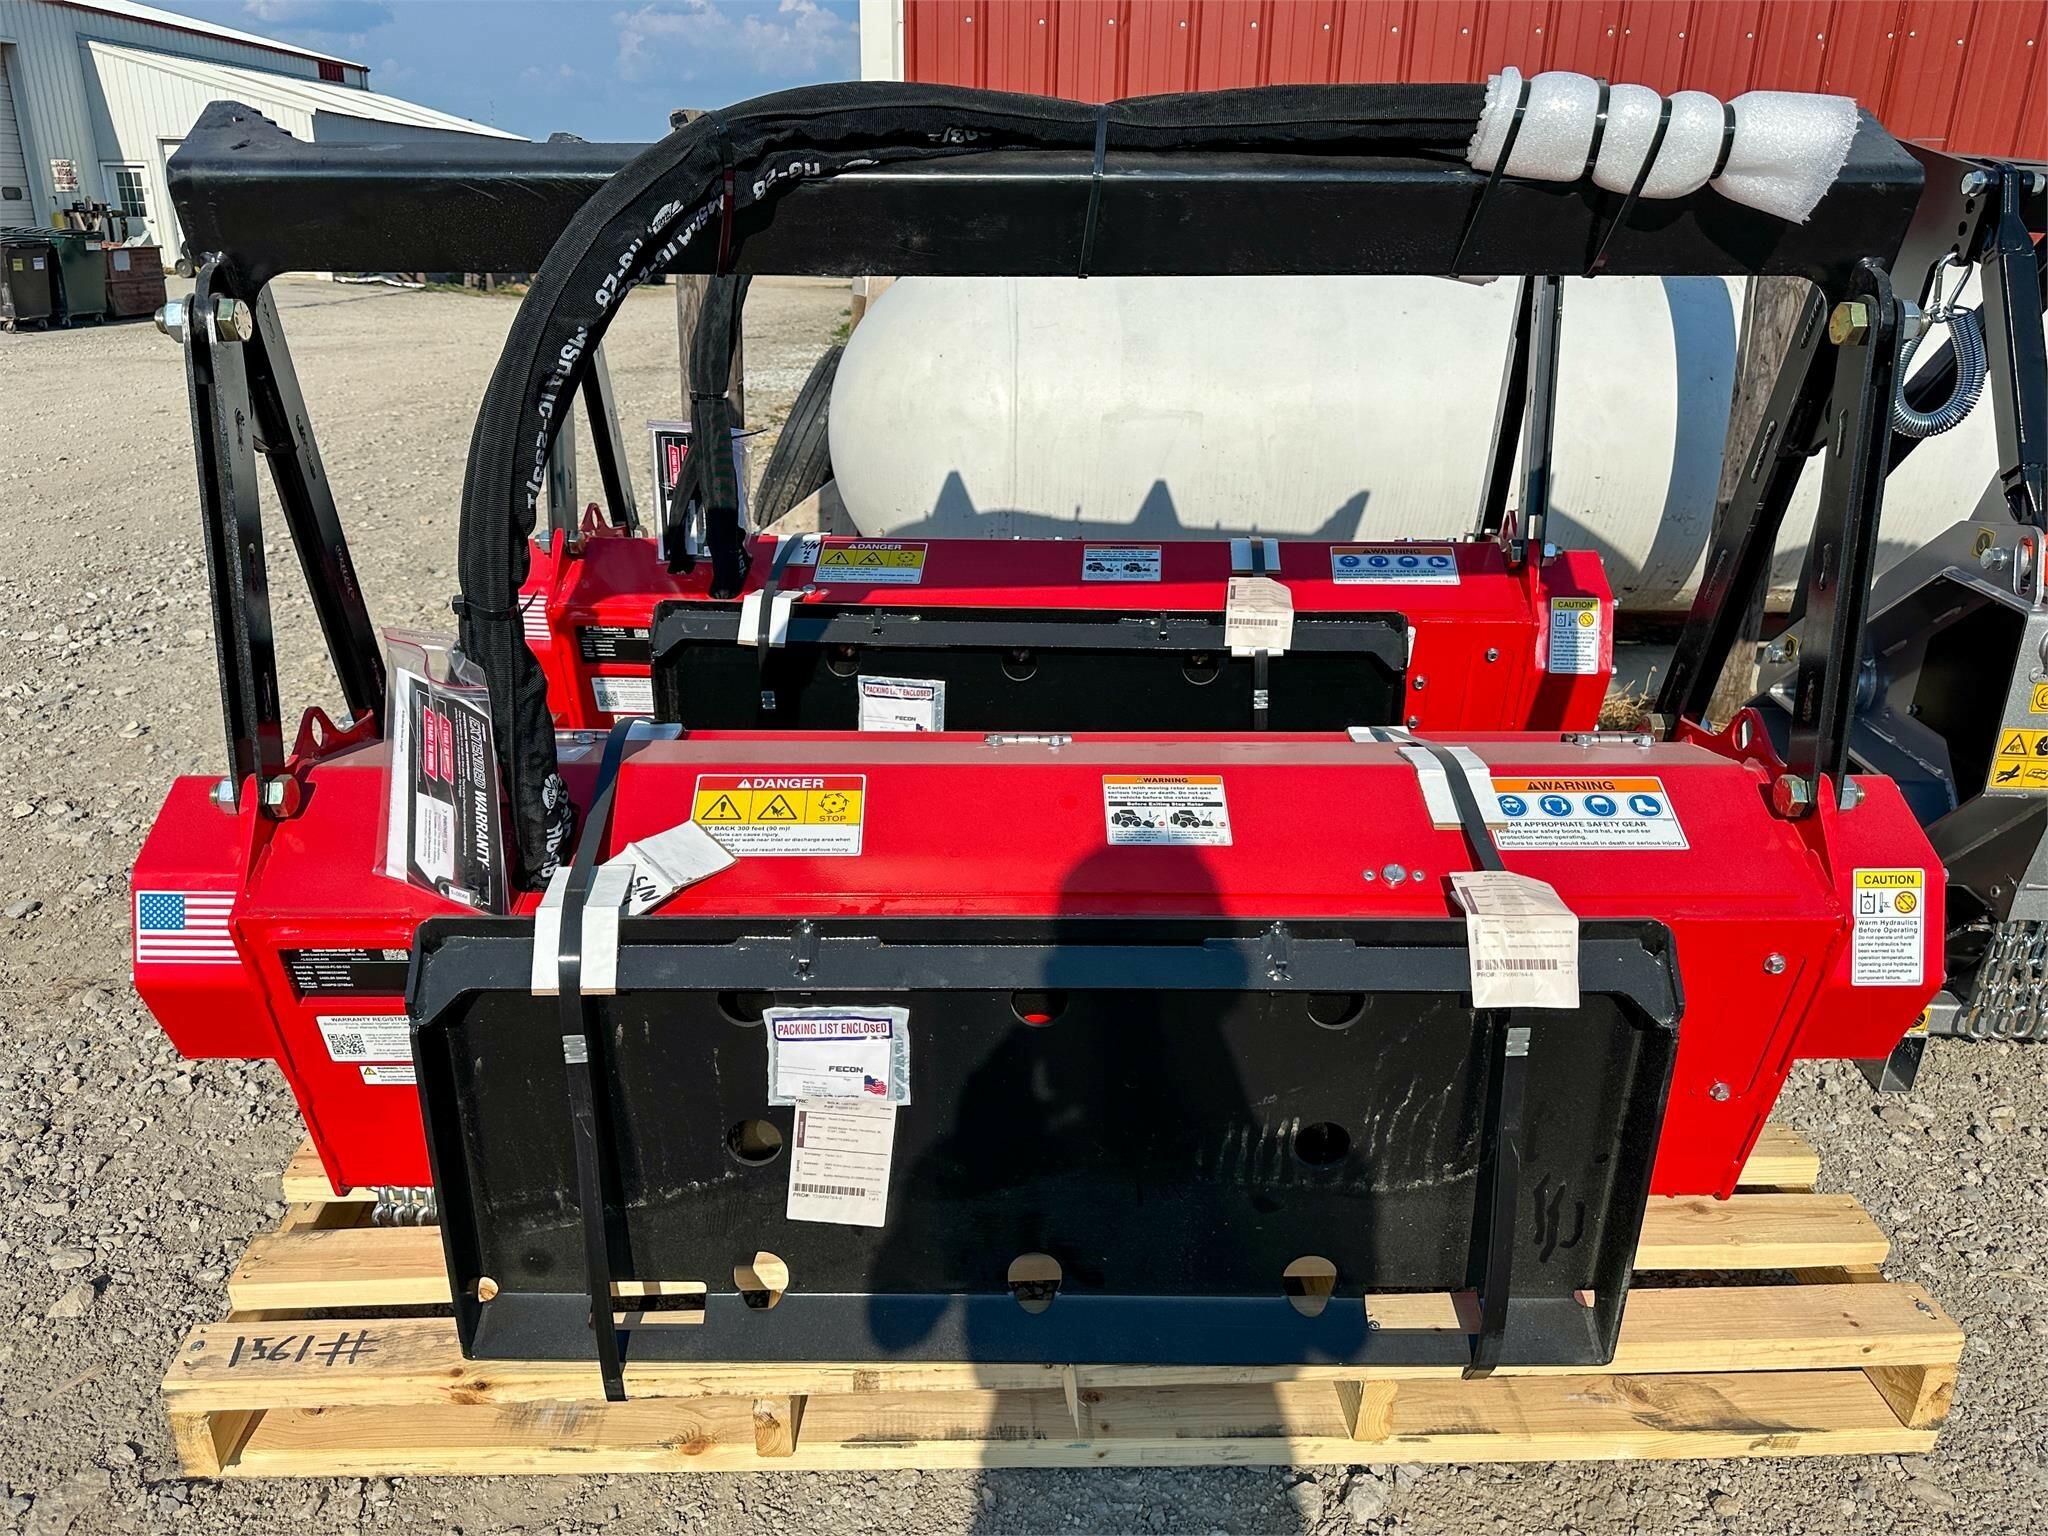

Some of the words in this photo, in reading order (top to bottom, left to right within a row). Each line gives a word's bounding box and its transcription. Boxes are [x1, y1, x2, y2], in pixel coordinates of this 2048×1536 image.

[866, 686, 889, 694] PACKING
[903, 689, 931, 697] ENCLOSED
[468, 716, 487, 790] EXTENDED
[753, 779, 824, 789] DANGER
[1539, 781, 1615, 791] WARNING
[475, 790, 490, 867] WARRANTY
[1864, 875, 1914, 884] CAUTION
[778, 1024, 816, 1036] PACKING
[819, 1023, 839, 1034] LIST
[841, 1022, 887, 1034] ENCLOSED
